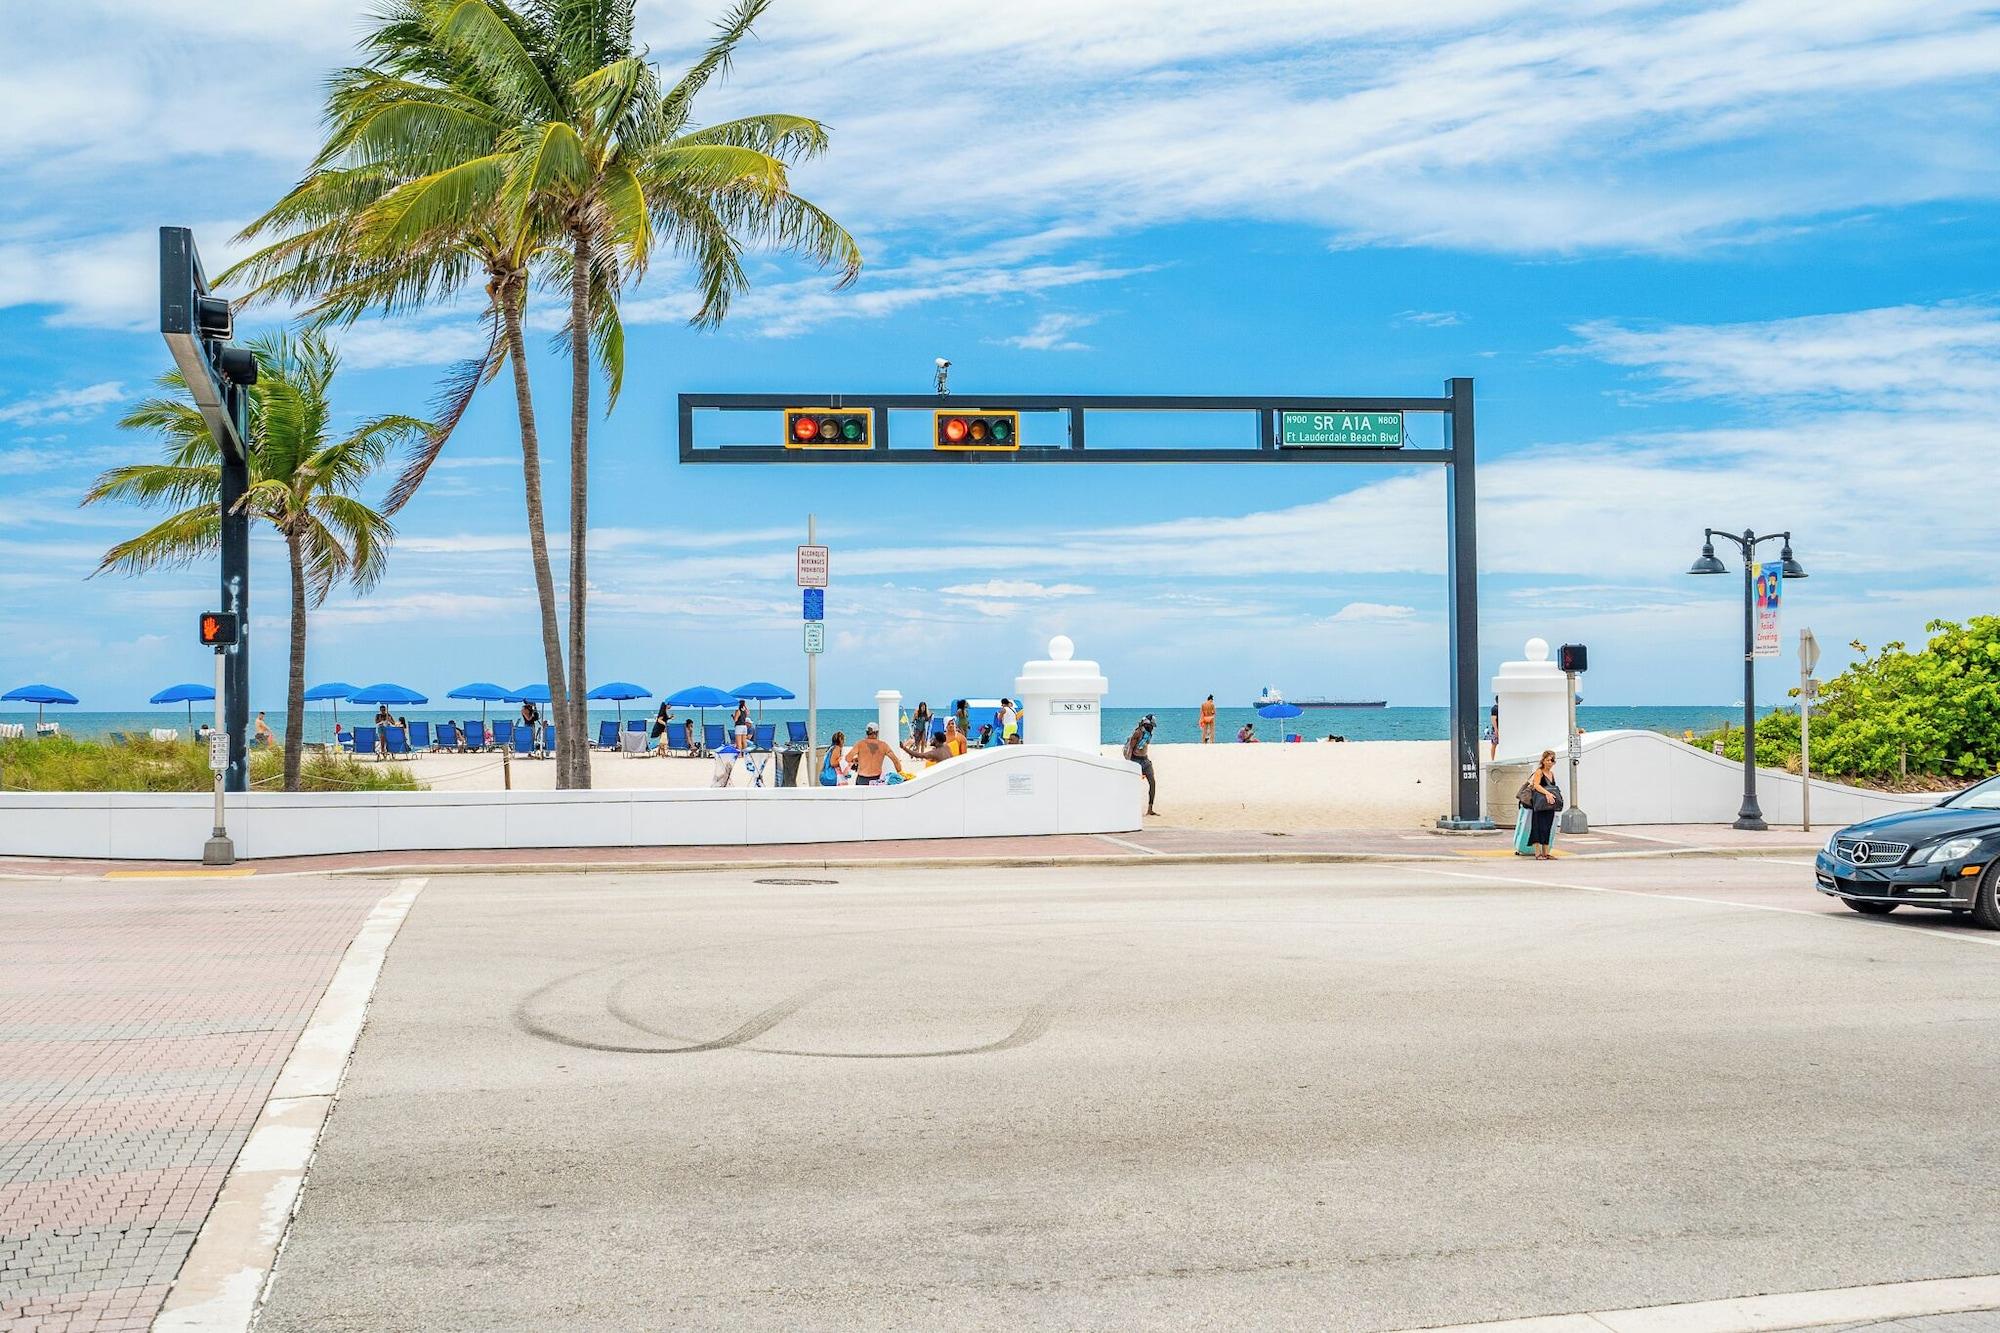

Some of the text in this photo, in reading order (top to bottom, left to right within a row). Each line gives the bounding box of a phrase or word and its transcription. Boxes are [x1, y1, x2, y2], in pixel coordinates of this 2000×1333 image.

[1313, 415, 1334, 431] SR
[1342, 415, 1372, 431] A1A
[1286, 431, 1399, 443] Ft Lauderdale Beach Blvd
